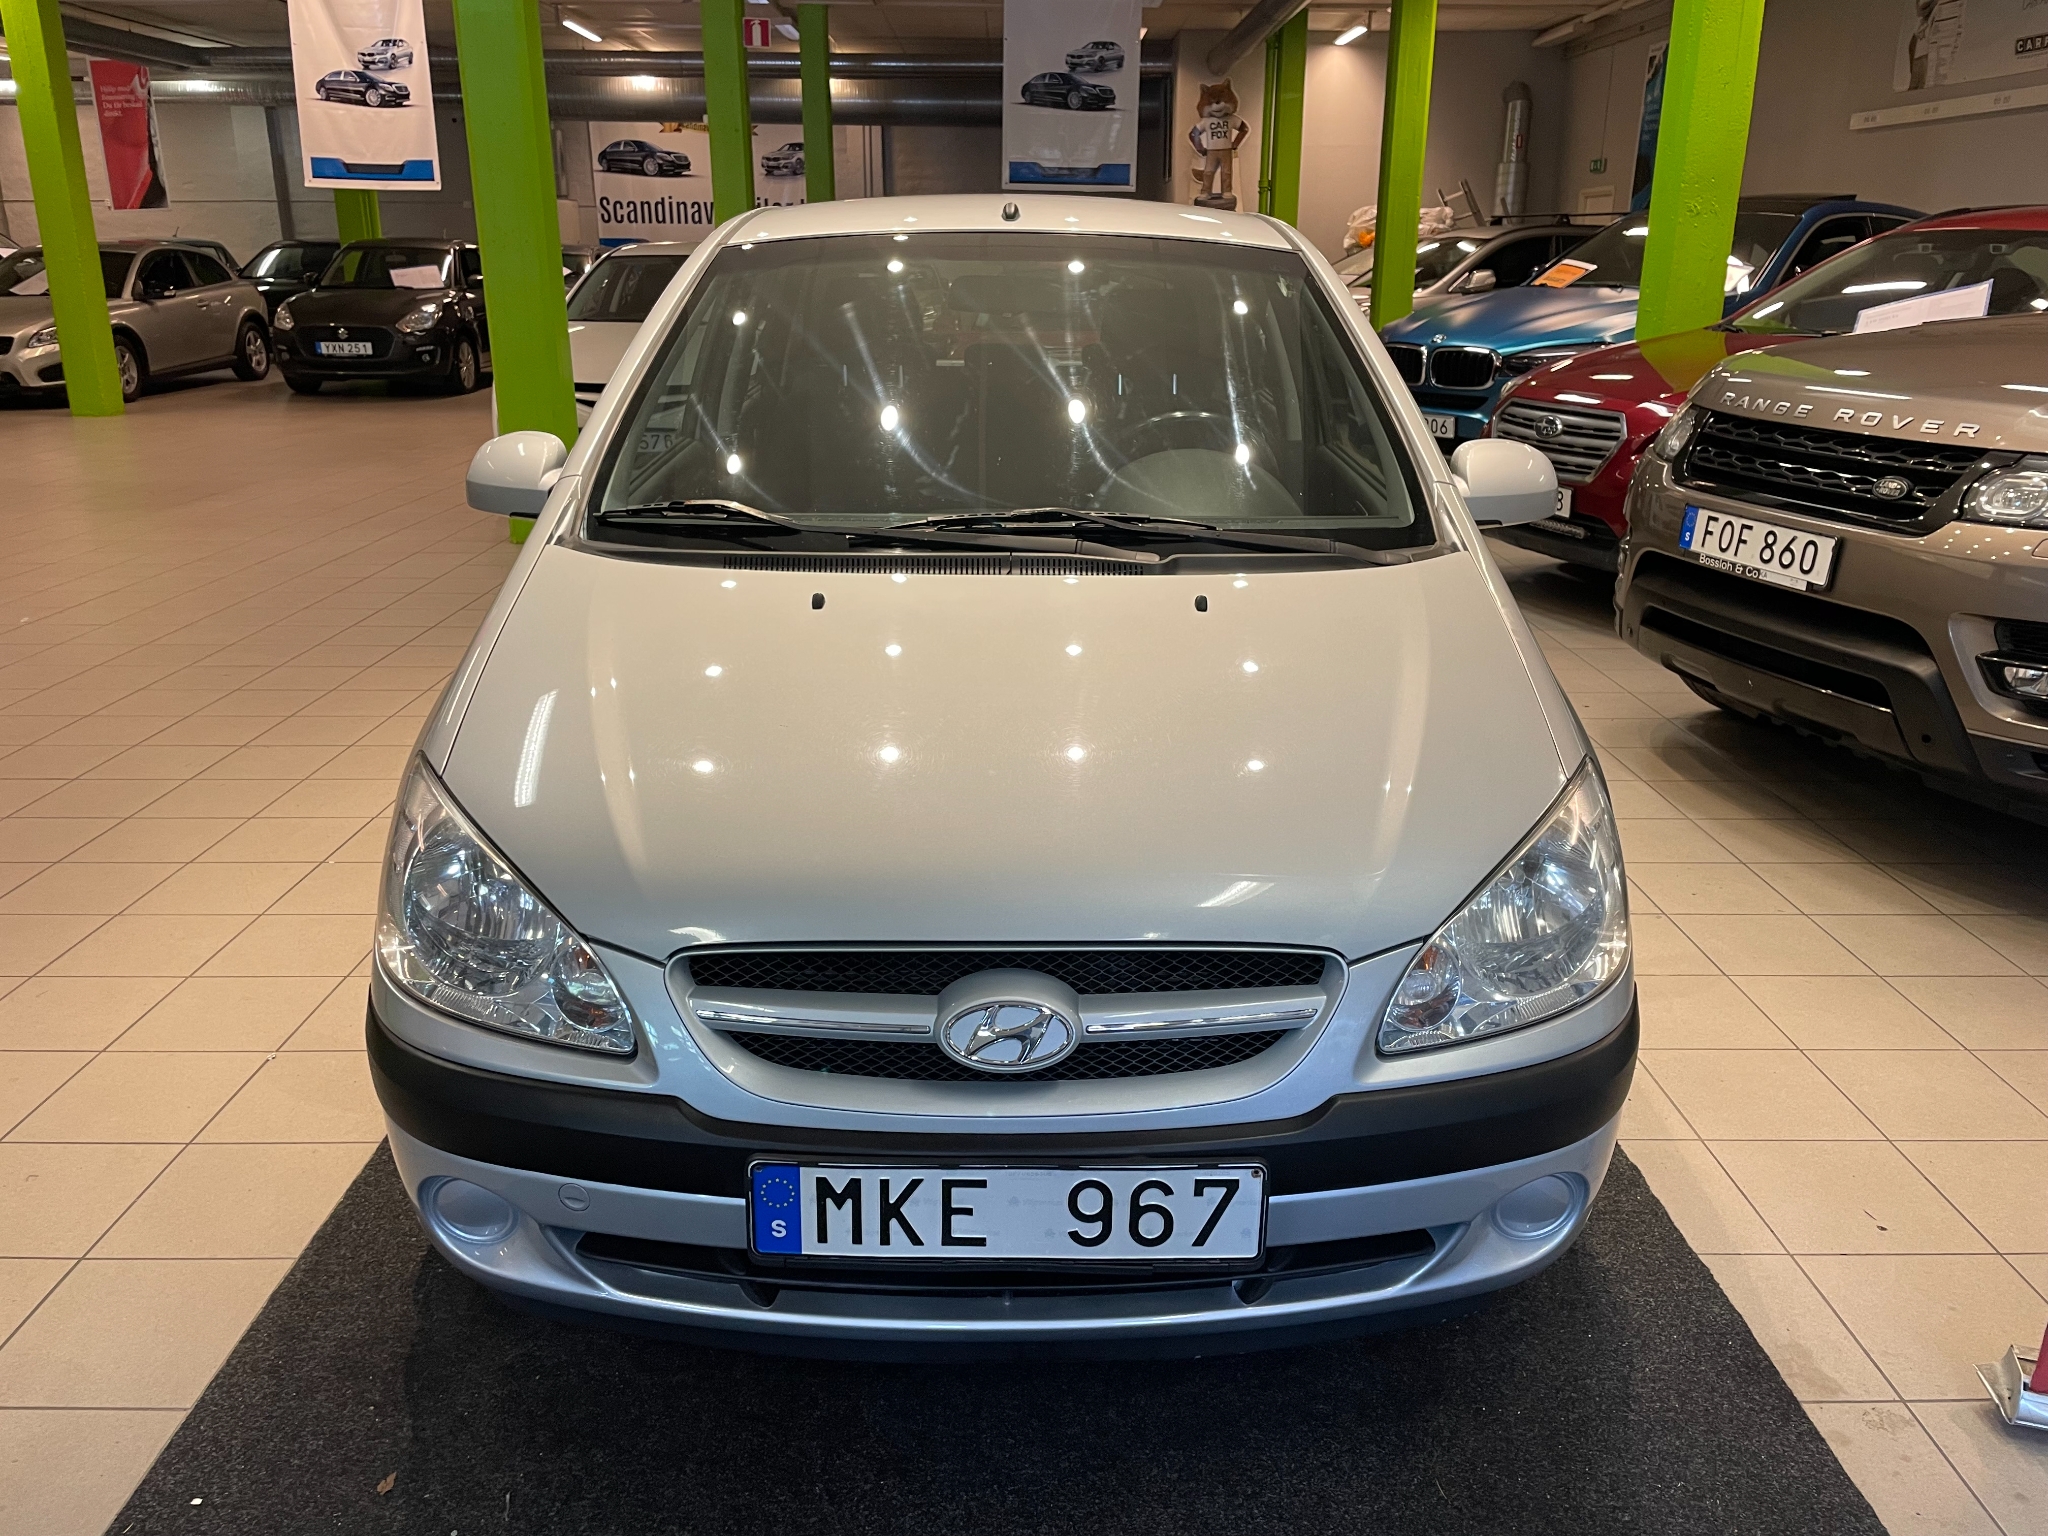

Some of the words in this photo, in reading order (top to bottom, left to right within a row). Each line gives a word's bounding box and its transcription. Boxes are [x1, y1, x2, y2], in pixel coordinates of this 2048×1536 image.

[1210, 121, 1229, 130] CAR
[1211, 130, 1228, 140] FOX
[600, 196, 714, 224] Scandinav
[324, 344, 345, 353] YXN
[347, 344, 368, 353] 251
[1720, 391, 1814, 419] RANGE
[1833, 407, 1980, 438] ROVER
[1684, 531, 1691, 542] S
[1701, 515, 1754, 557] FOF
[1759, 530, 1819, 575] 860
[1735, 563, 1744, 574] &
[1745, 566, 1758, 578] Co
[815, 1176, 988, 1246] MKE
[1067, 1178, 1240, 1248] 967
[771, 1219, 787, 1238] S
